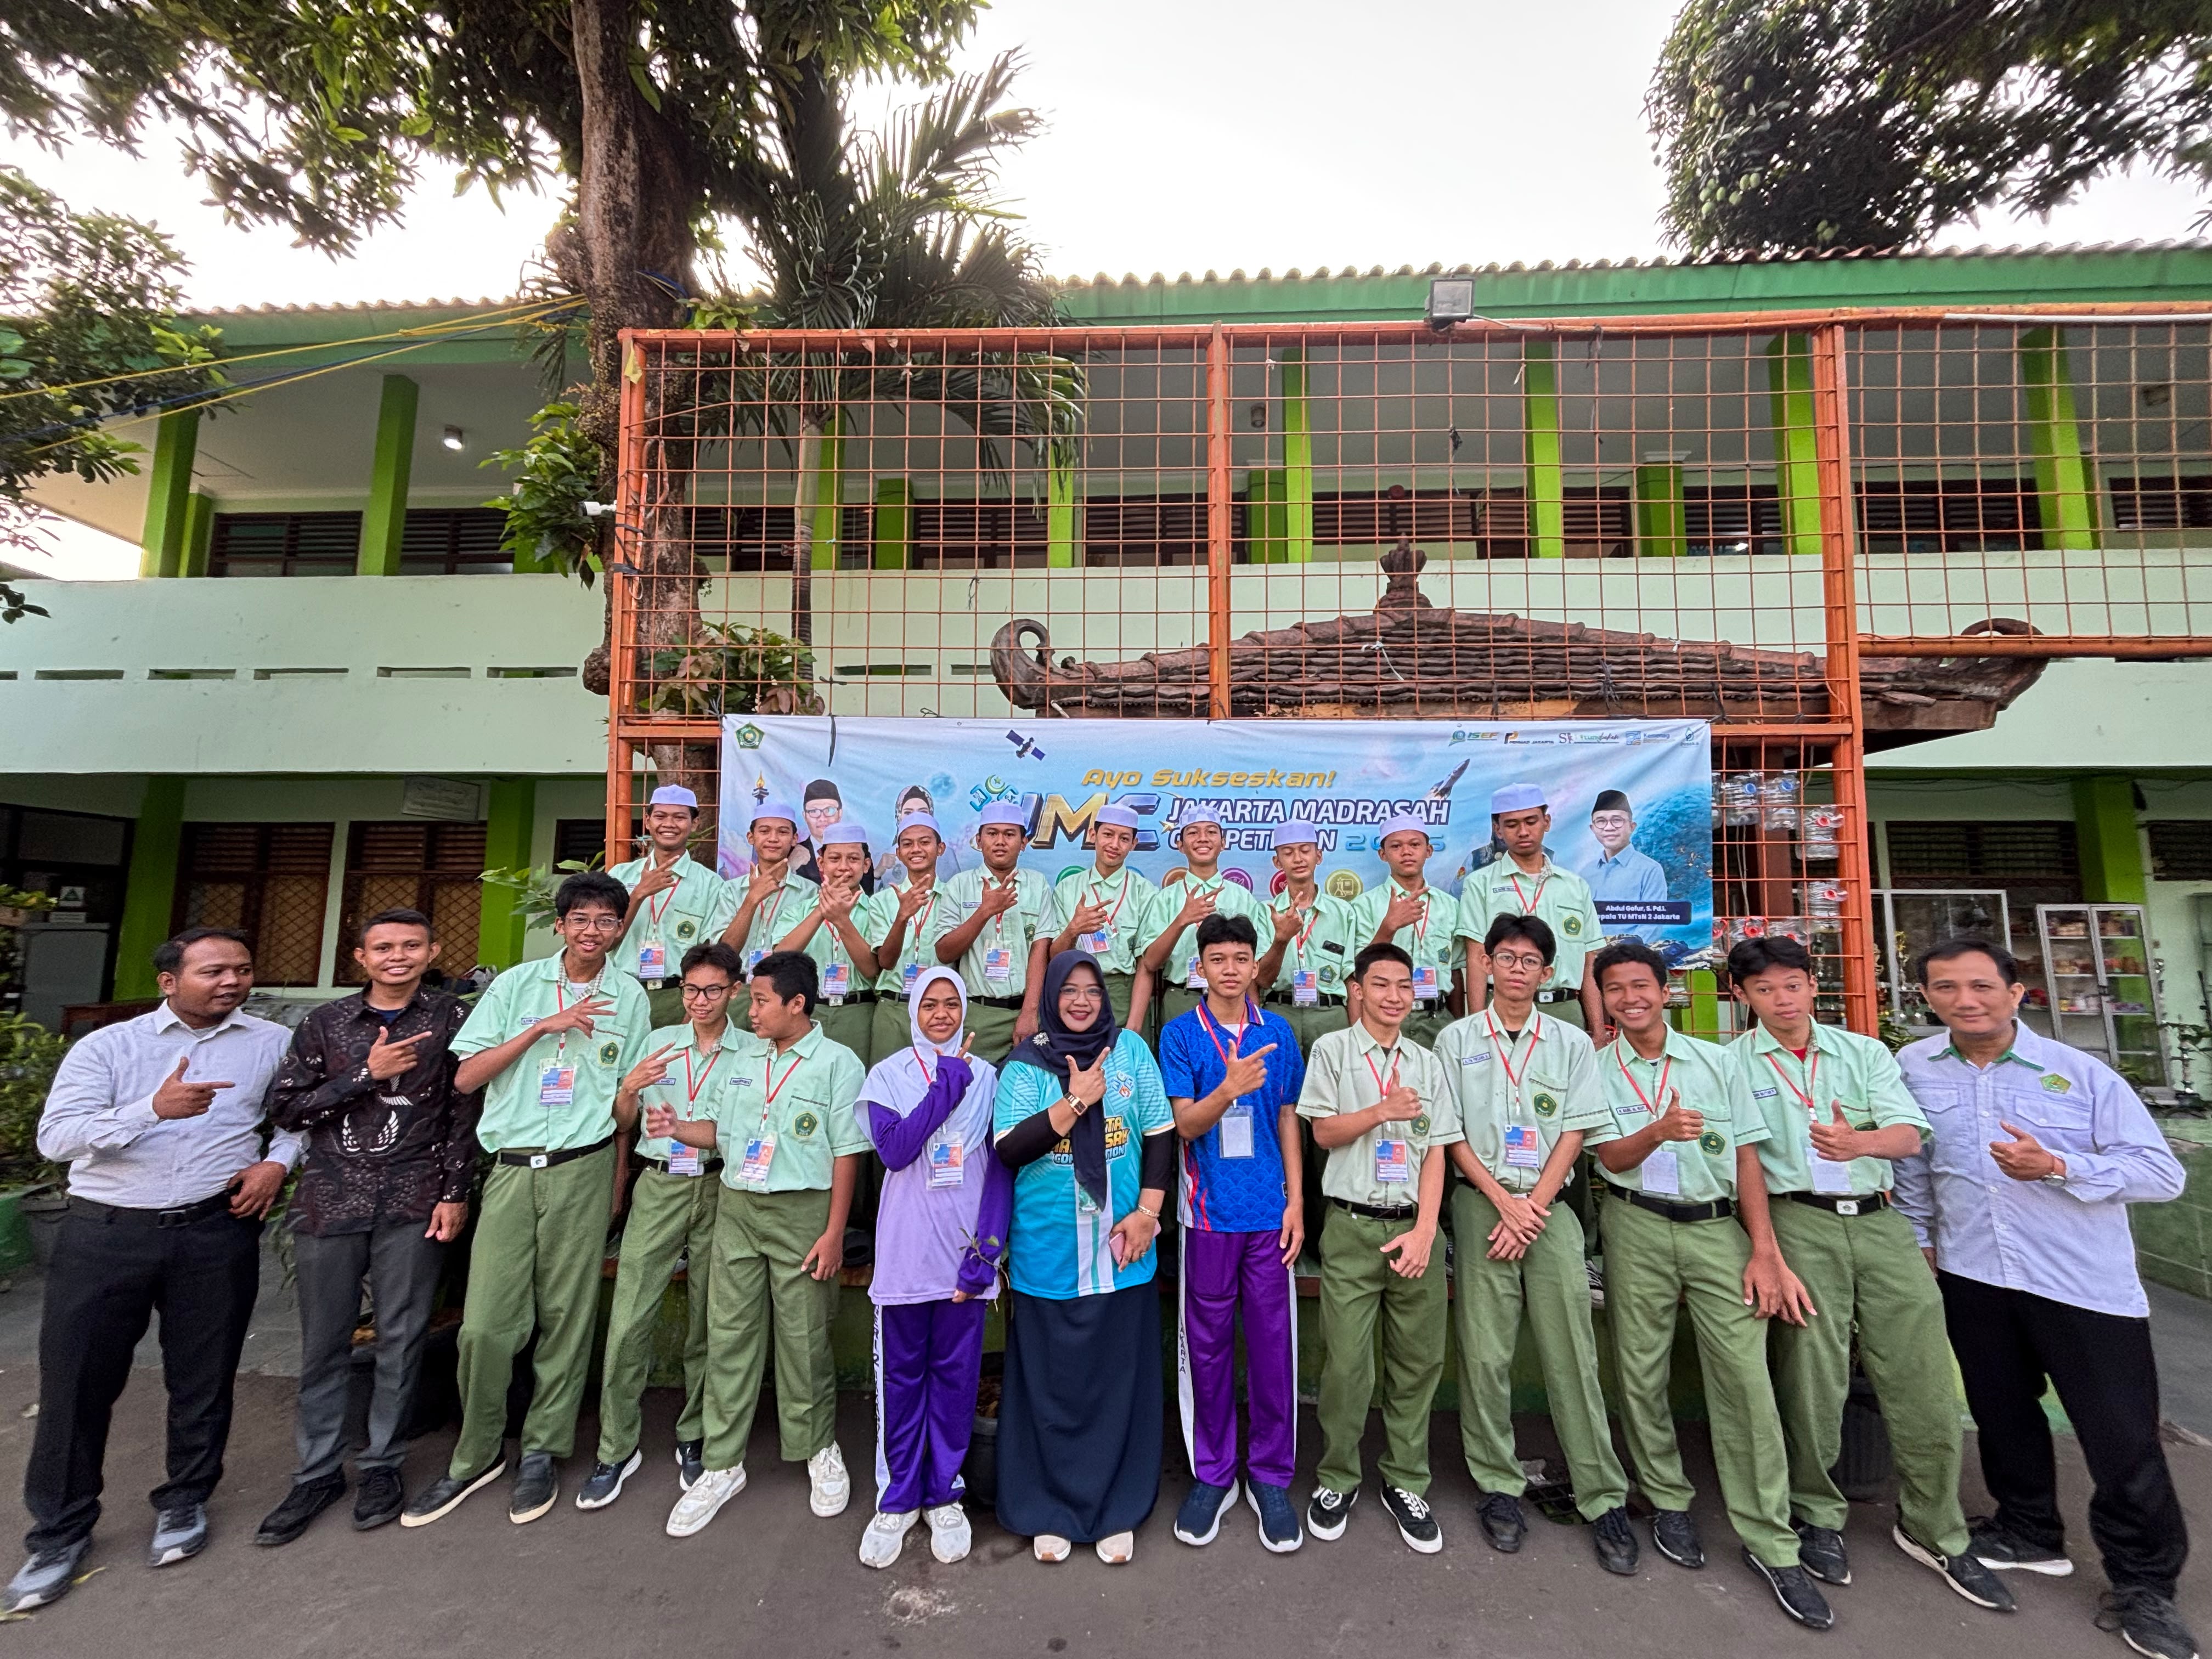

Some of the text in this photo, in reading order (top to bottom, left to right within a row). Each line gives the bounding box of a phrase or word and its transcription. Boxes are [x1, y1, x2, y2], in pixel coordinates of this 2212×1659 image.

[1082, 768, 1338, 789] Ayo Sukseskan!
[1168, 798, 1286, 824] JARTA
